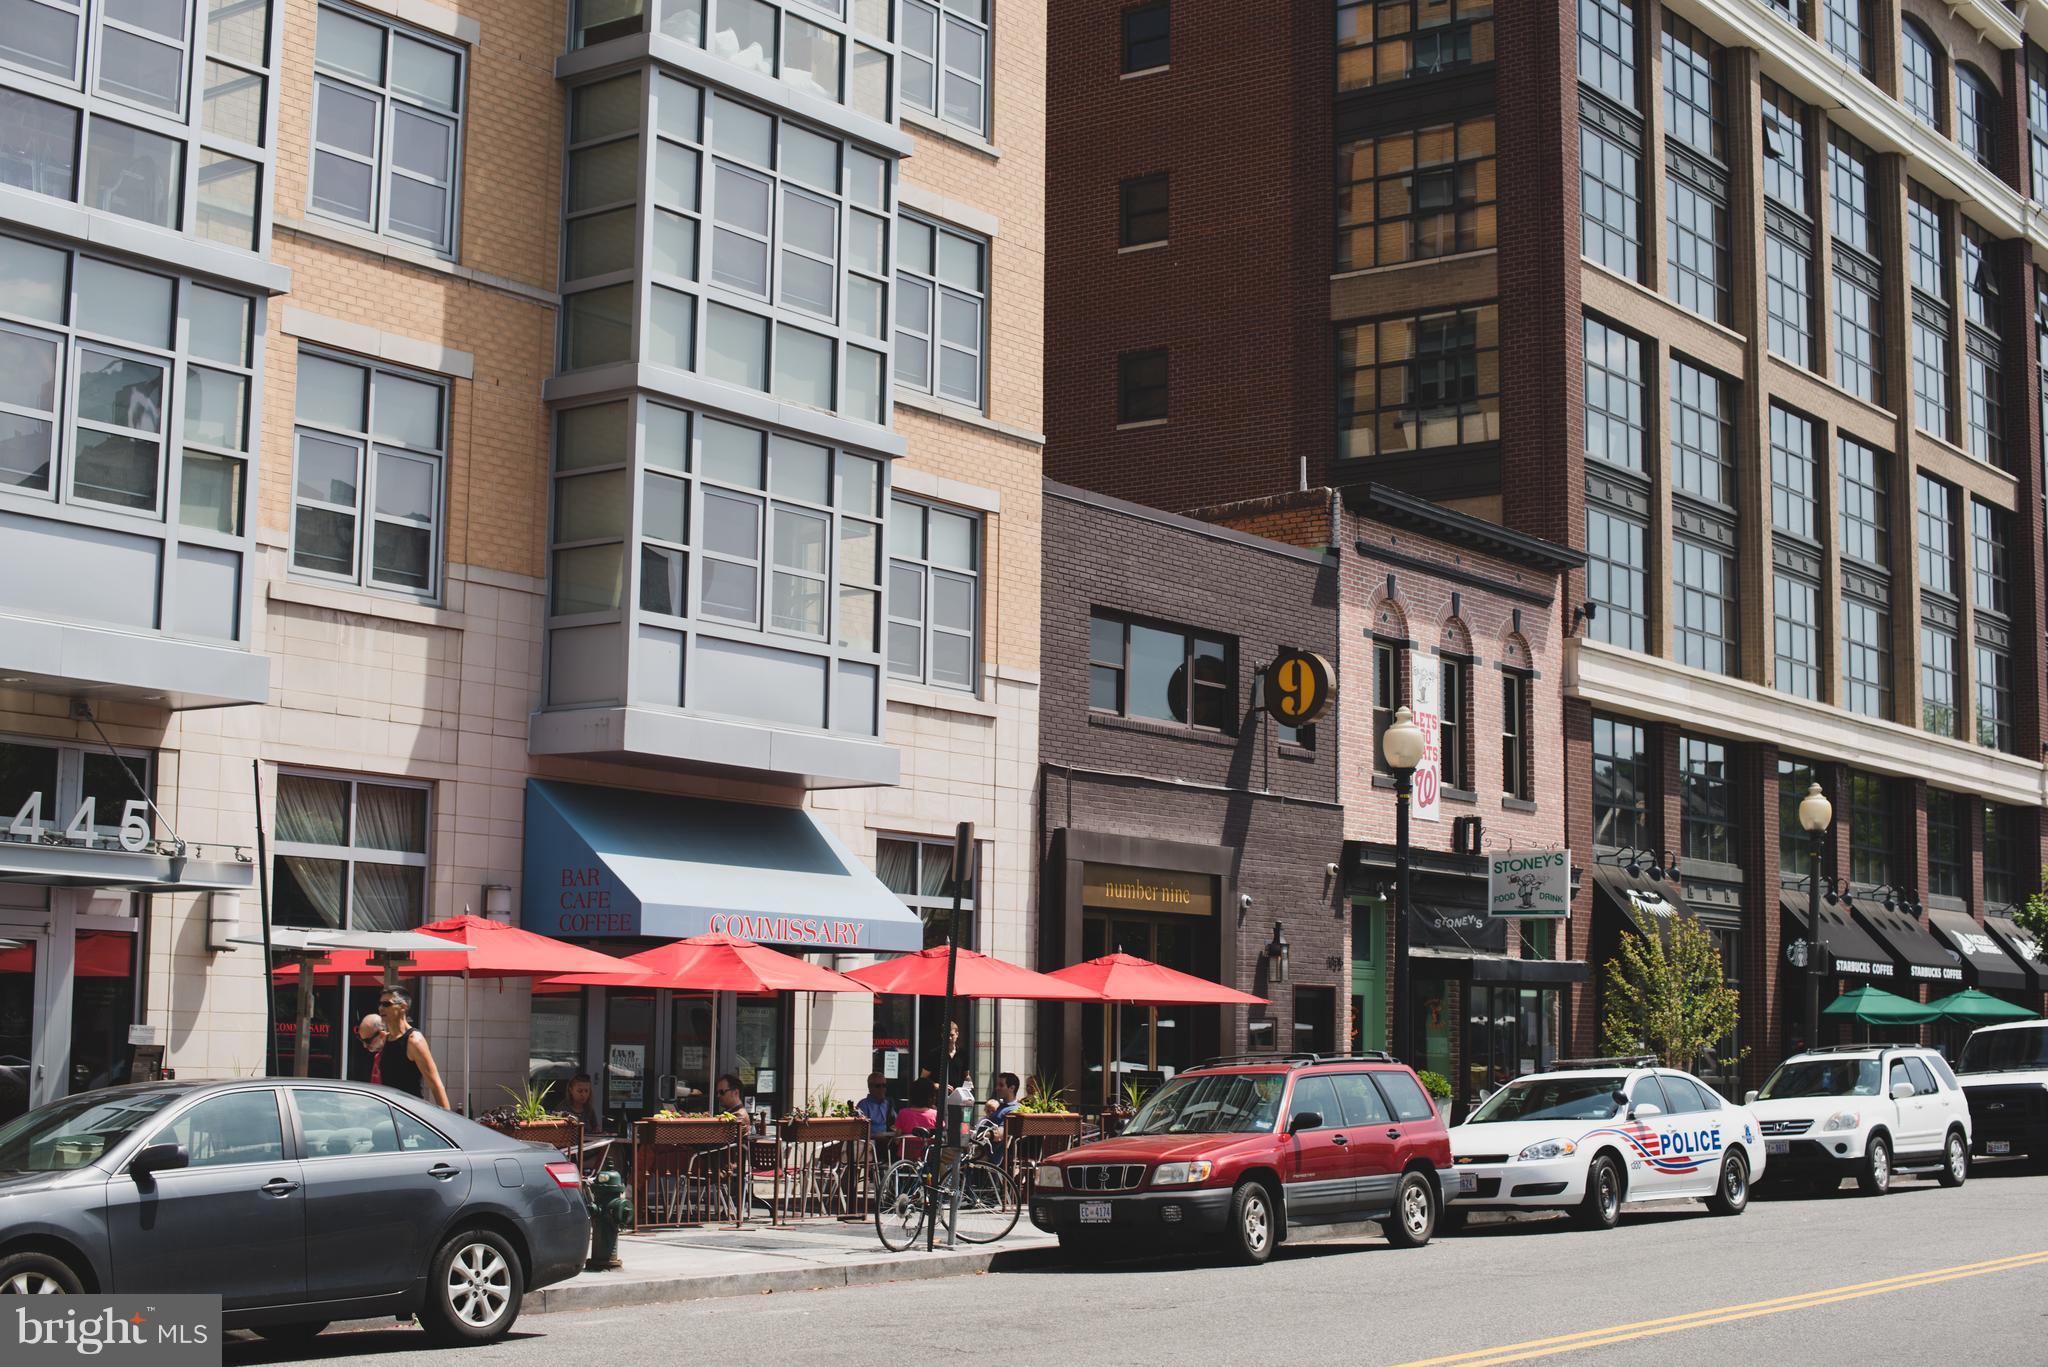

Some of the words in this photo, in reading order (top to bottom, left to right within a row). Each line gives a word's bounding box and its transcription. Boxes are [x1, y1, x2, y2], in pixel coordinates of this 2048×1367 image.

[1278, 658, 1316, 716] 9
[1413, 710, 1438, 730] LETS
[1422, 745, 1438, 762] ATS
[9, 791, 151, 852] 445
[1494, 853, 1564, 874] STONEY'S
[561, 867, 600, 887] BAR
[560, 891, 611, 909] CAFE
[1105, 879, 1159, 901] number
[1162, 882, 1190, 904] nine
[1493, 892, 1516, 903] FOOD
[1539, 892, 1564, 903] DRINK
[559, 913, 632, 932] COFFEE
[709, 912, 864, 946] COMMISSARY
[1434, 914, 1483, 929] STONEY'S
[1836, 960, 1871, 974] STARBUCKS
[1872, 963, 1894, 976] COFFEE
[1910, 965, 1942, 978] STARBUCKS
[1943, 968, 1963, 980] COFFEE
[1660, 1129, 1722, 1155] POLICE
